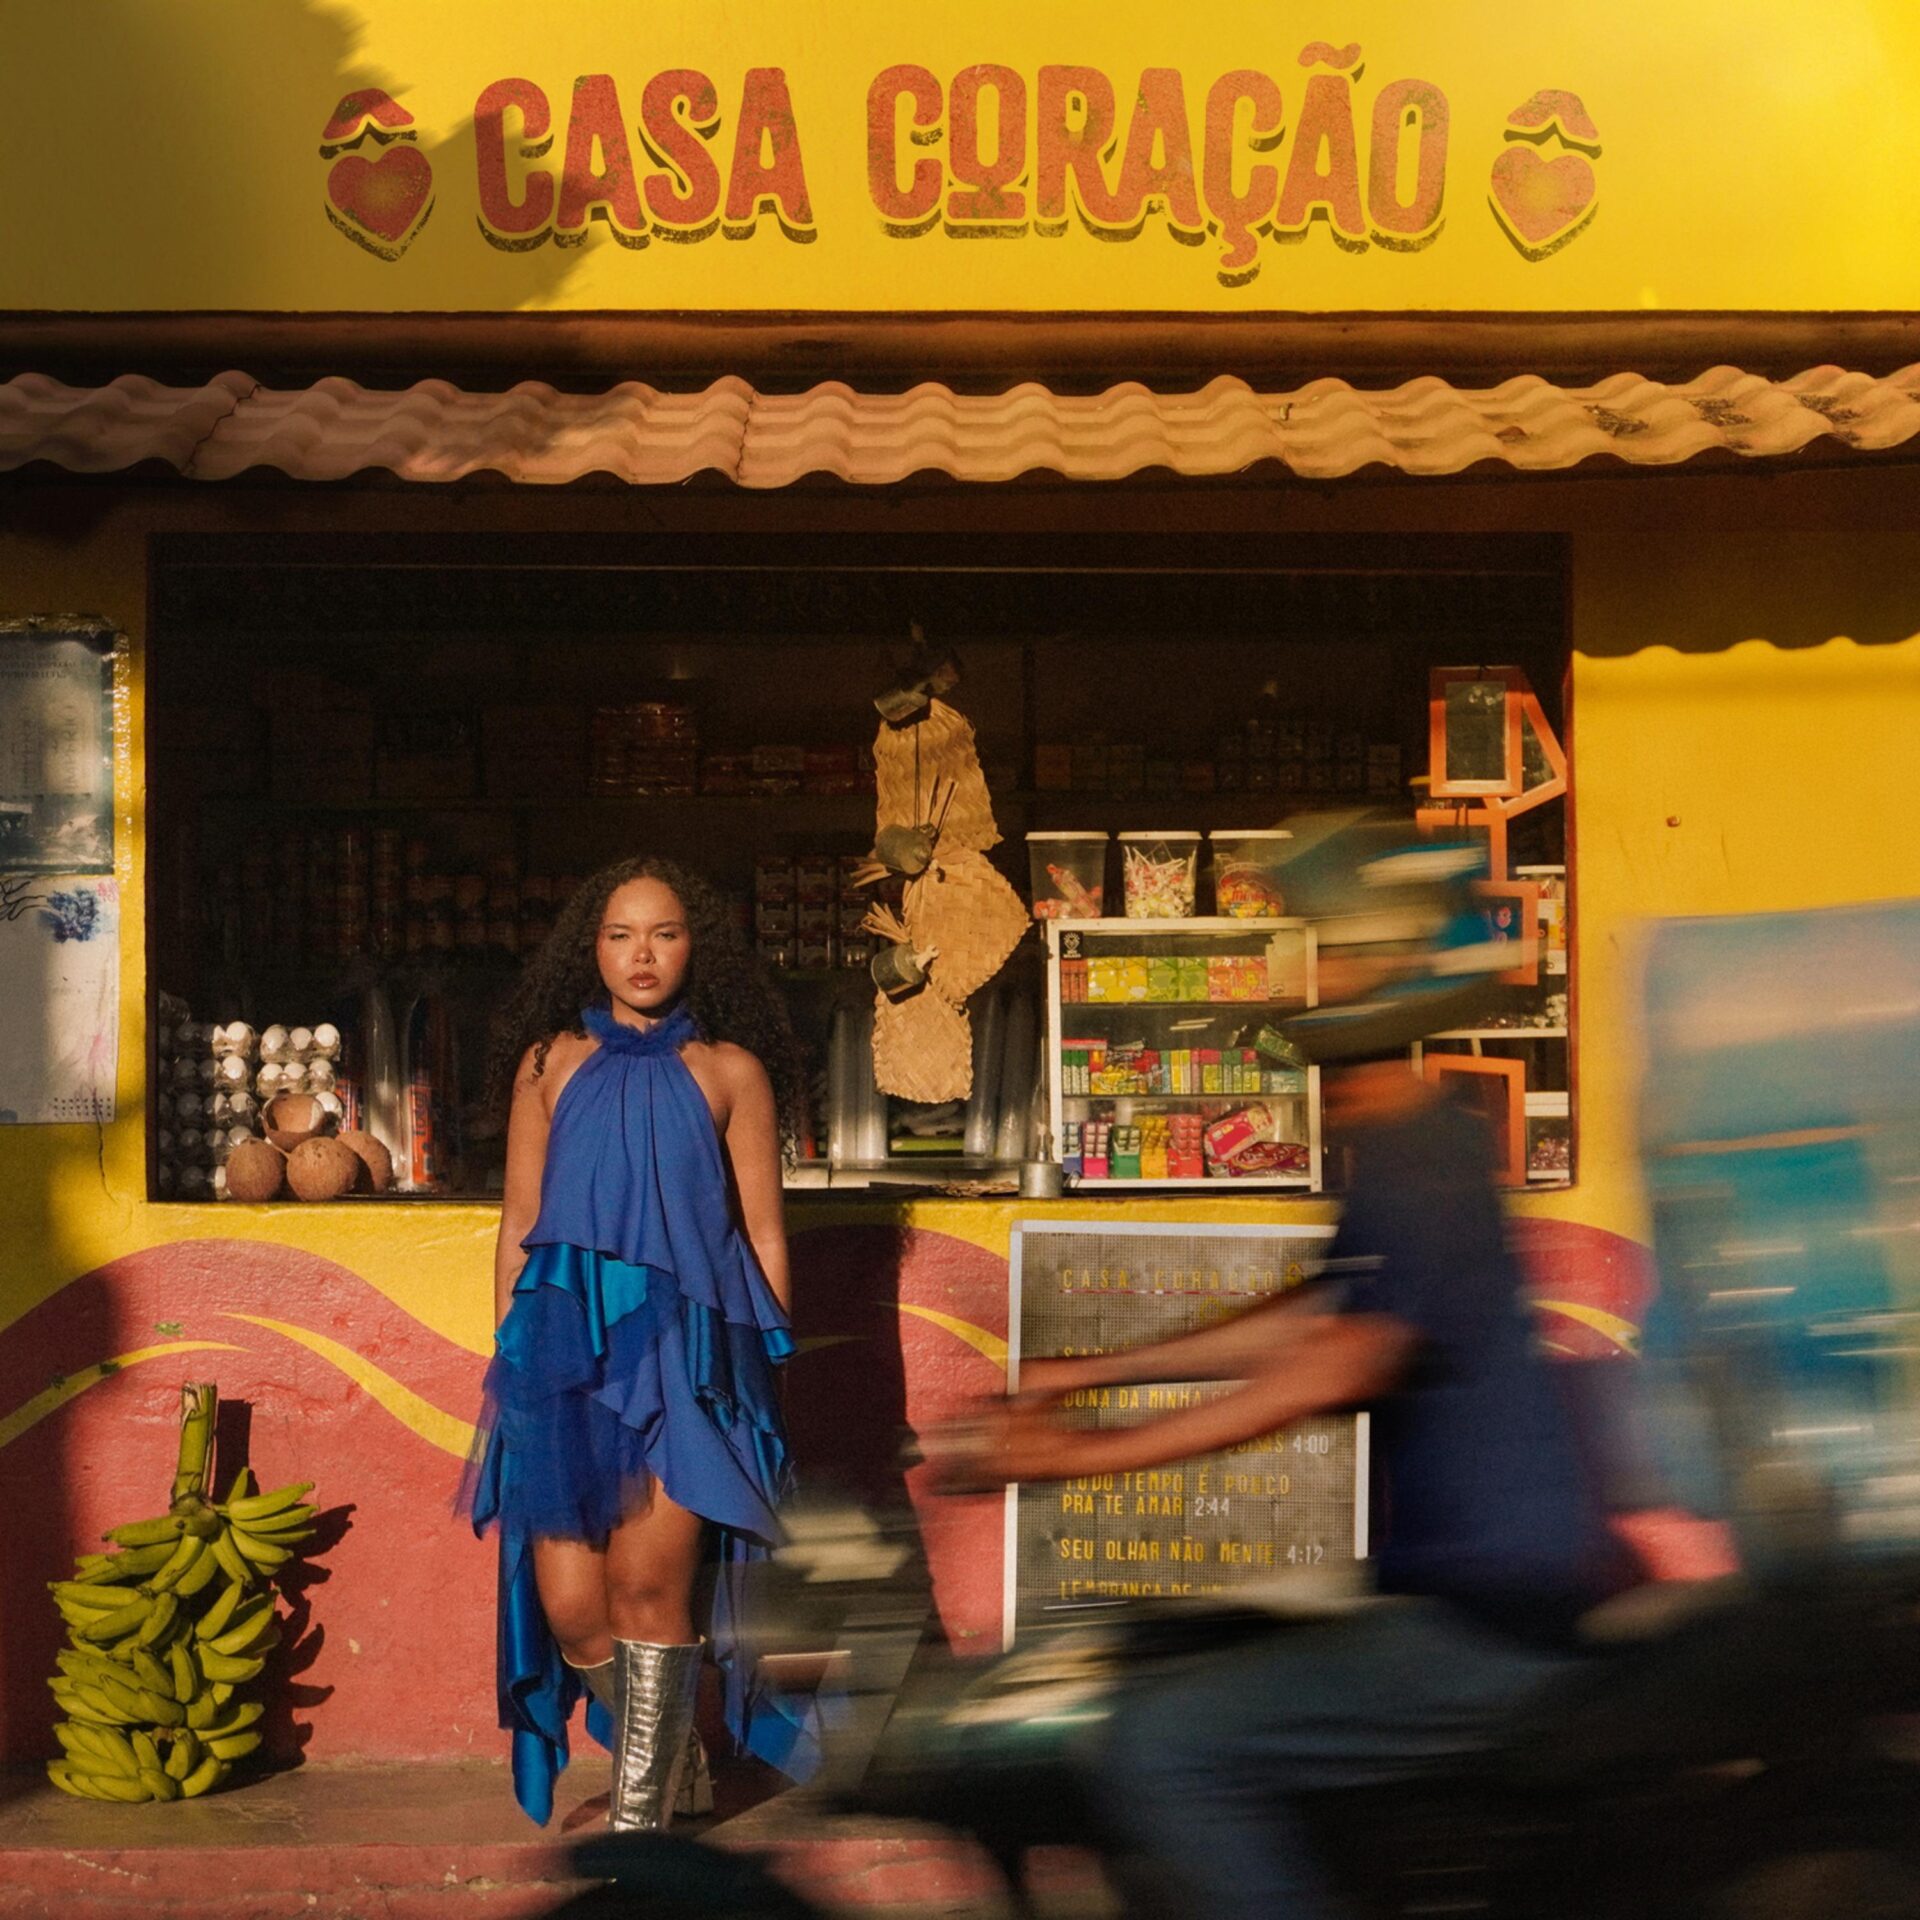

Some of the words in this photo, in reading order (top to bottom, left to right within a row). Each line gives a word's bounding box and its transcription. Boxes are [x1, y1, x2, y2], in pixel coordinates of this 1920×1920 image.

[475, 66, 817, 252] CASA
[866, 41, 1451, 287] CORAÇÃO
[1063, 1268, 1130, 1289] CASA
[1119, 1387, 1139, 1408] DA
[1148, 1387, 1203, 1409] MINHA
[1293, 1433, 1329, 1455] 4:00
[1123, 1471, 1183, 1493] TEMPO
[1199, 1463, 1210, 1494] É
[1224, 1474, 1290, 1495] POUCO
[1062, 1494, 1094, 1514] PRA
[1105, 1494, 1124, 1515] TE
[1136, 1495, 1184, 1516] AMAR
[1195, 1496, 1229, 1517] 2:44
[1060, 1538, 1095, 1560] SEU
[1105, 1540, 1160, 1561] OLHAR
[1169, 1535, 1205, 1563] NÃO
[1219, 1540, 1275, 1565] MENTE
[1287, 1544, 1324, 1566] 4:12
